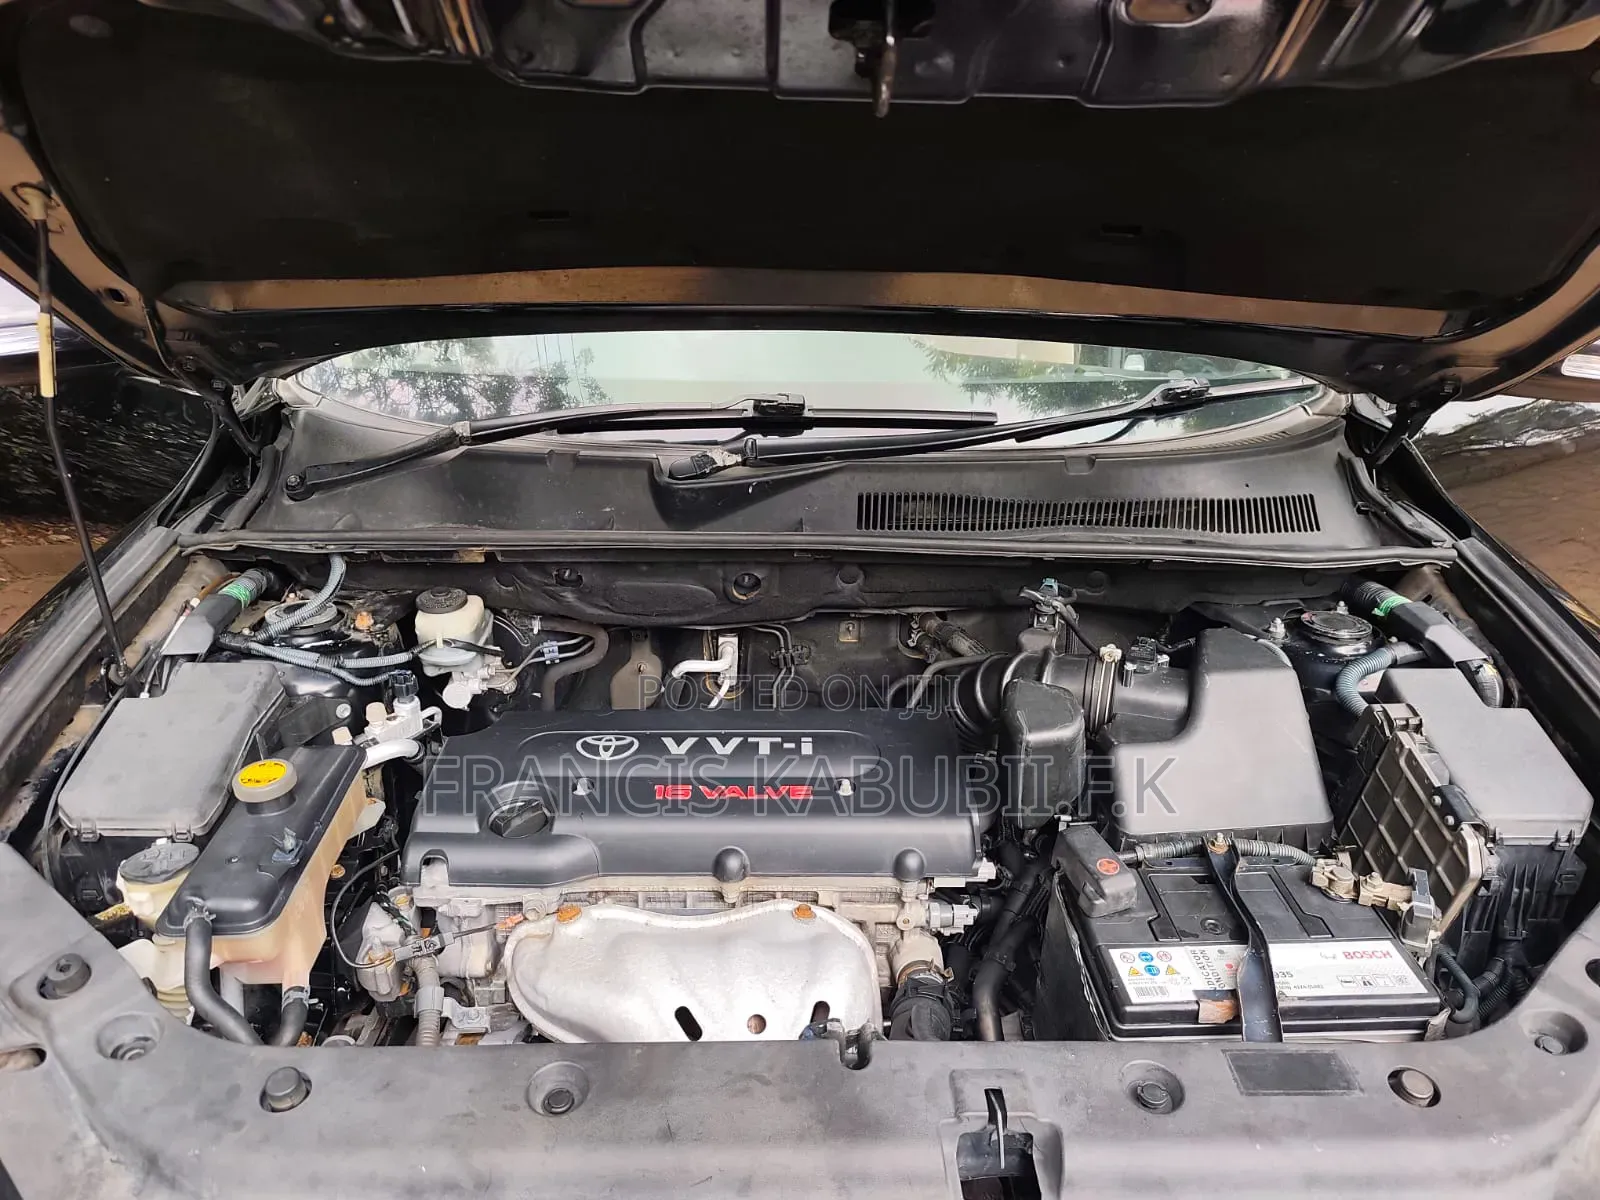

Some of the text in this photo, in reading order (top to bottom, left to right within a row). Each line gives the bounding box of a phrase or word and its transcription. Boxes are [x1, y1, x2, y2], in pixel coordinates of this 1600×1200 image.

[660, 736, 814, 756] VVT-i
[653, 784, 814, 800] 16 VALVE
[1342, 950, 1393, 960] BOSCH
